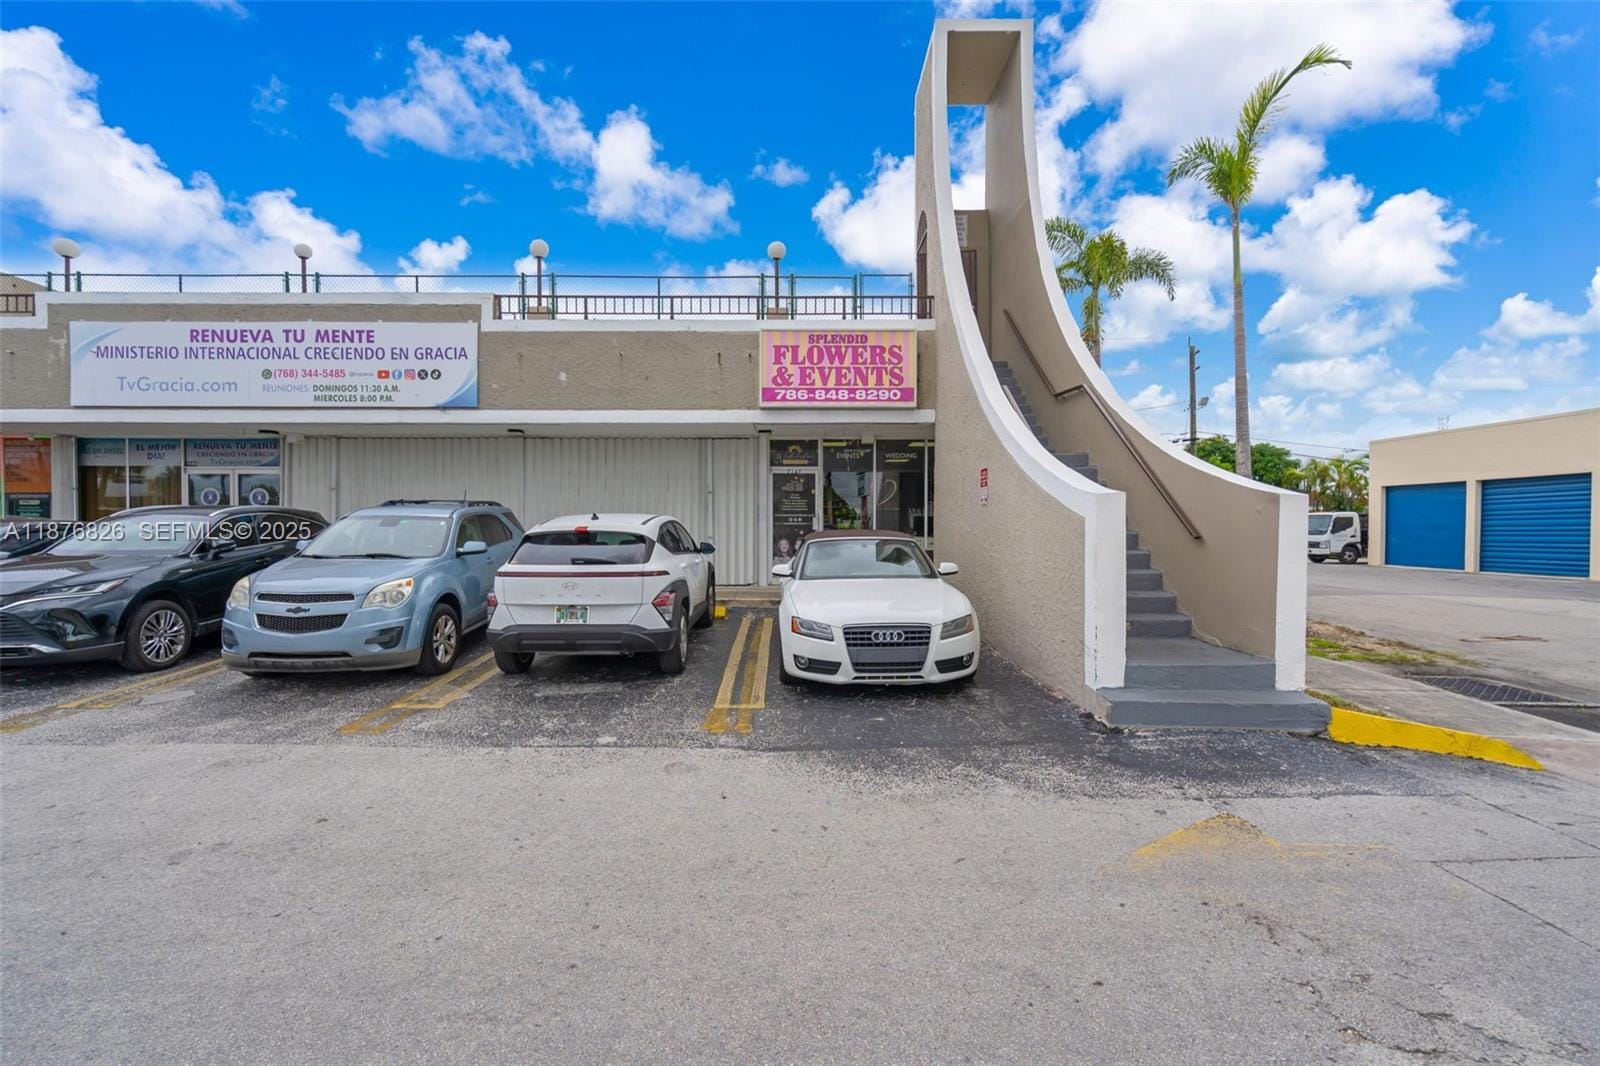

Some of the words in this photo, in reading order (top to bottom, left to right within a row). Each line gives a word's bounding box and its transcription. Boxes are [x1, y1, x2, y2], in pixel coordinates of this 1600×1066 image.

[189, 329, 274, 343] RENUEVA
[282, 329, 306, 343] TU
[315, 329, 375, 343] MENTE
[808, 334, 868, 344] SPLENDID
[96, 346, 179, 360] MINISTERIO
[184, 346, 300, 360] INTERNACIONAL
[304, 346, 386, 360] CRECIENDO
[391, 347, 409, 360] EN
[414, 347, 468, 360] GRACIA
[772, 345, 904, 365] FLOWERS
[273, 369, 298, 380] (768)
[301, 369, 346, 379] 344-5485
[771, 366, 794, 386] &
[798, 366, 905, 386] EVENTS
[117, 376, 238, 393] TvGracia.com
[312, 384, 358, 393] DOMINGOS
[360, 384, 381, 393] 11:30
[383, 384, 401, 393] A.M.
[313, 394, 358, 403] MIERCOLES
[359, 394, 377, 403] 8:00
[774, 389, 901, 400] 786-848-8290
[135, 443, 145, 451] EL
[147, 443, 177, 451] MEJOR
[836, 452, 860, 460] EVENTS
